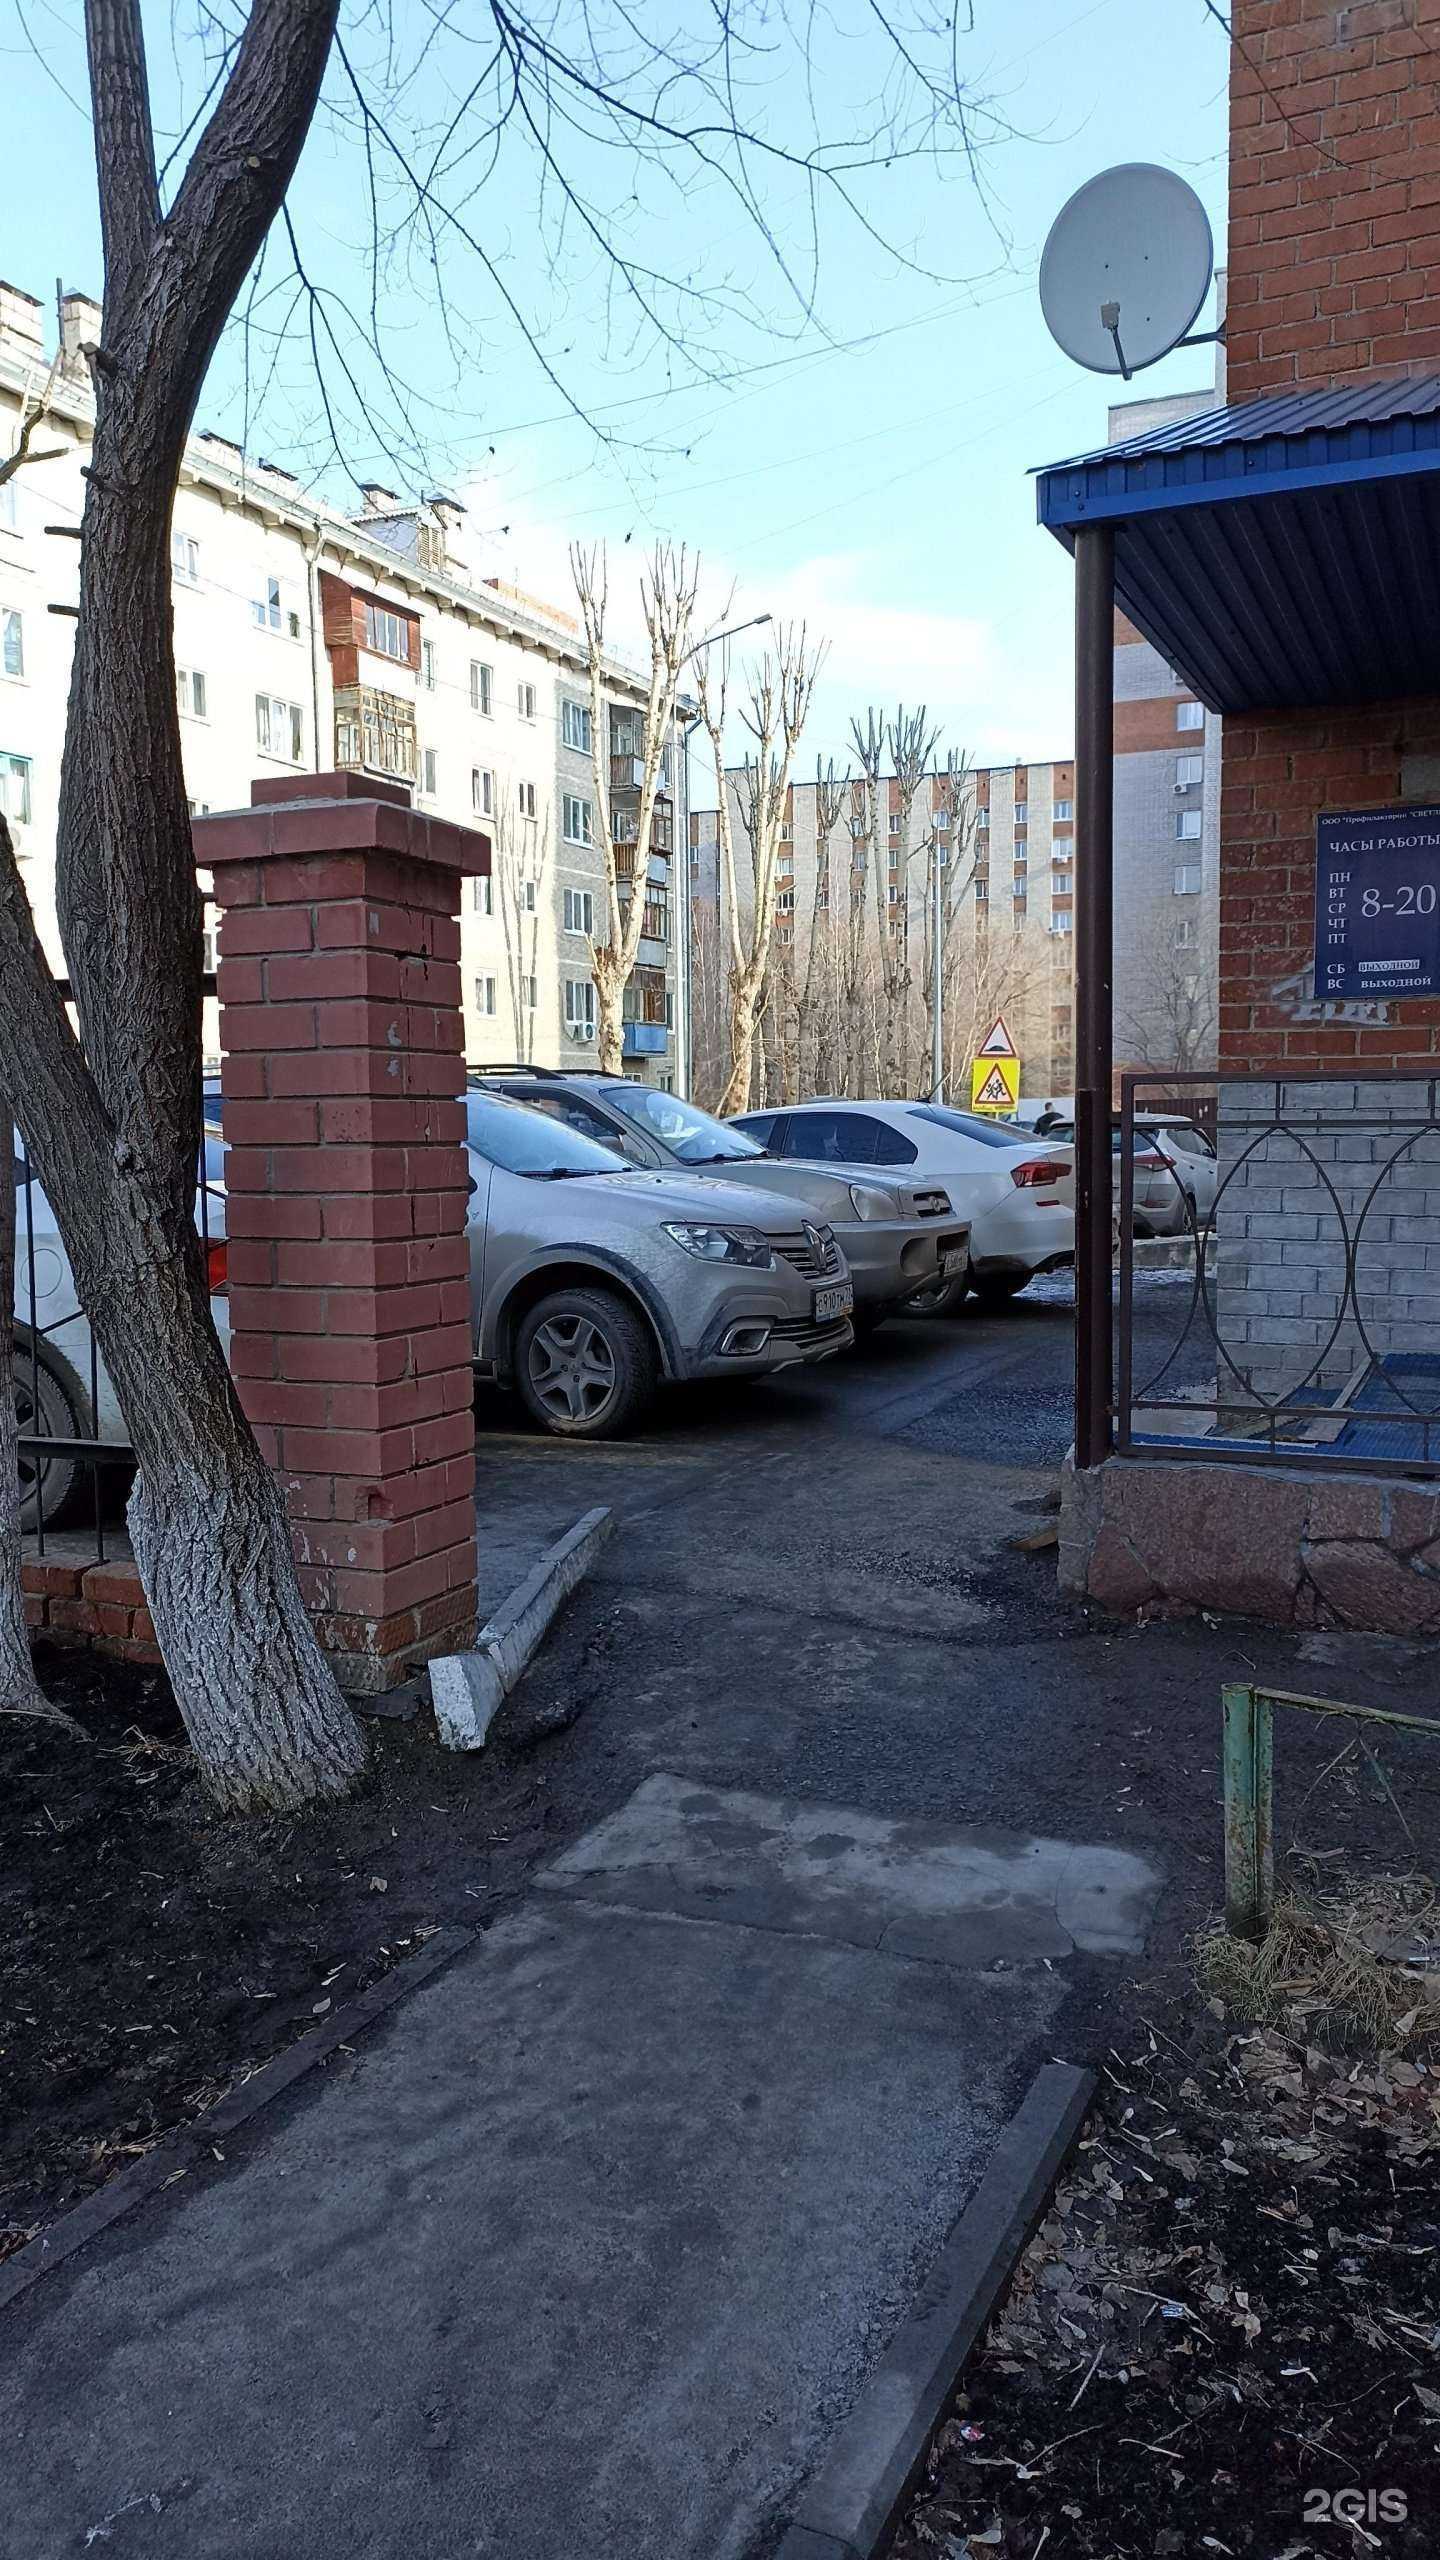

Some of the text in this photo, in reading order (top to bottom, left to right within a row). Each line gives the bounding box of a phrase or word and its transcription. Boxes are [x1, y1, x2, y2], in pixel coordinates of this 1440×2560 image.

[1321, 817, 1341, 825] ООО
[1329, 834, 1440, 852] ЧАСЫ РАБОТЫ
[1329, 872, 1351, 883] ПН
[1329, 887, 1346, 899] ВТ
[1361, 884, 1437, 918] 8-20
[1328, 903, 1346, 914] СР
[1328, 918, 1346, 929] ЧТ
[1328, 933, 1347, 944] ПТ
[1327, 963, 1346, 974] СБ
[1327, 979, 1345, 989] ВС
